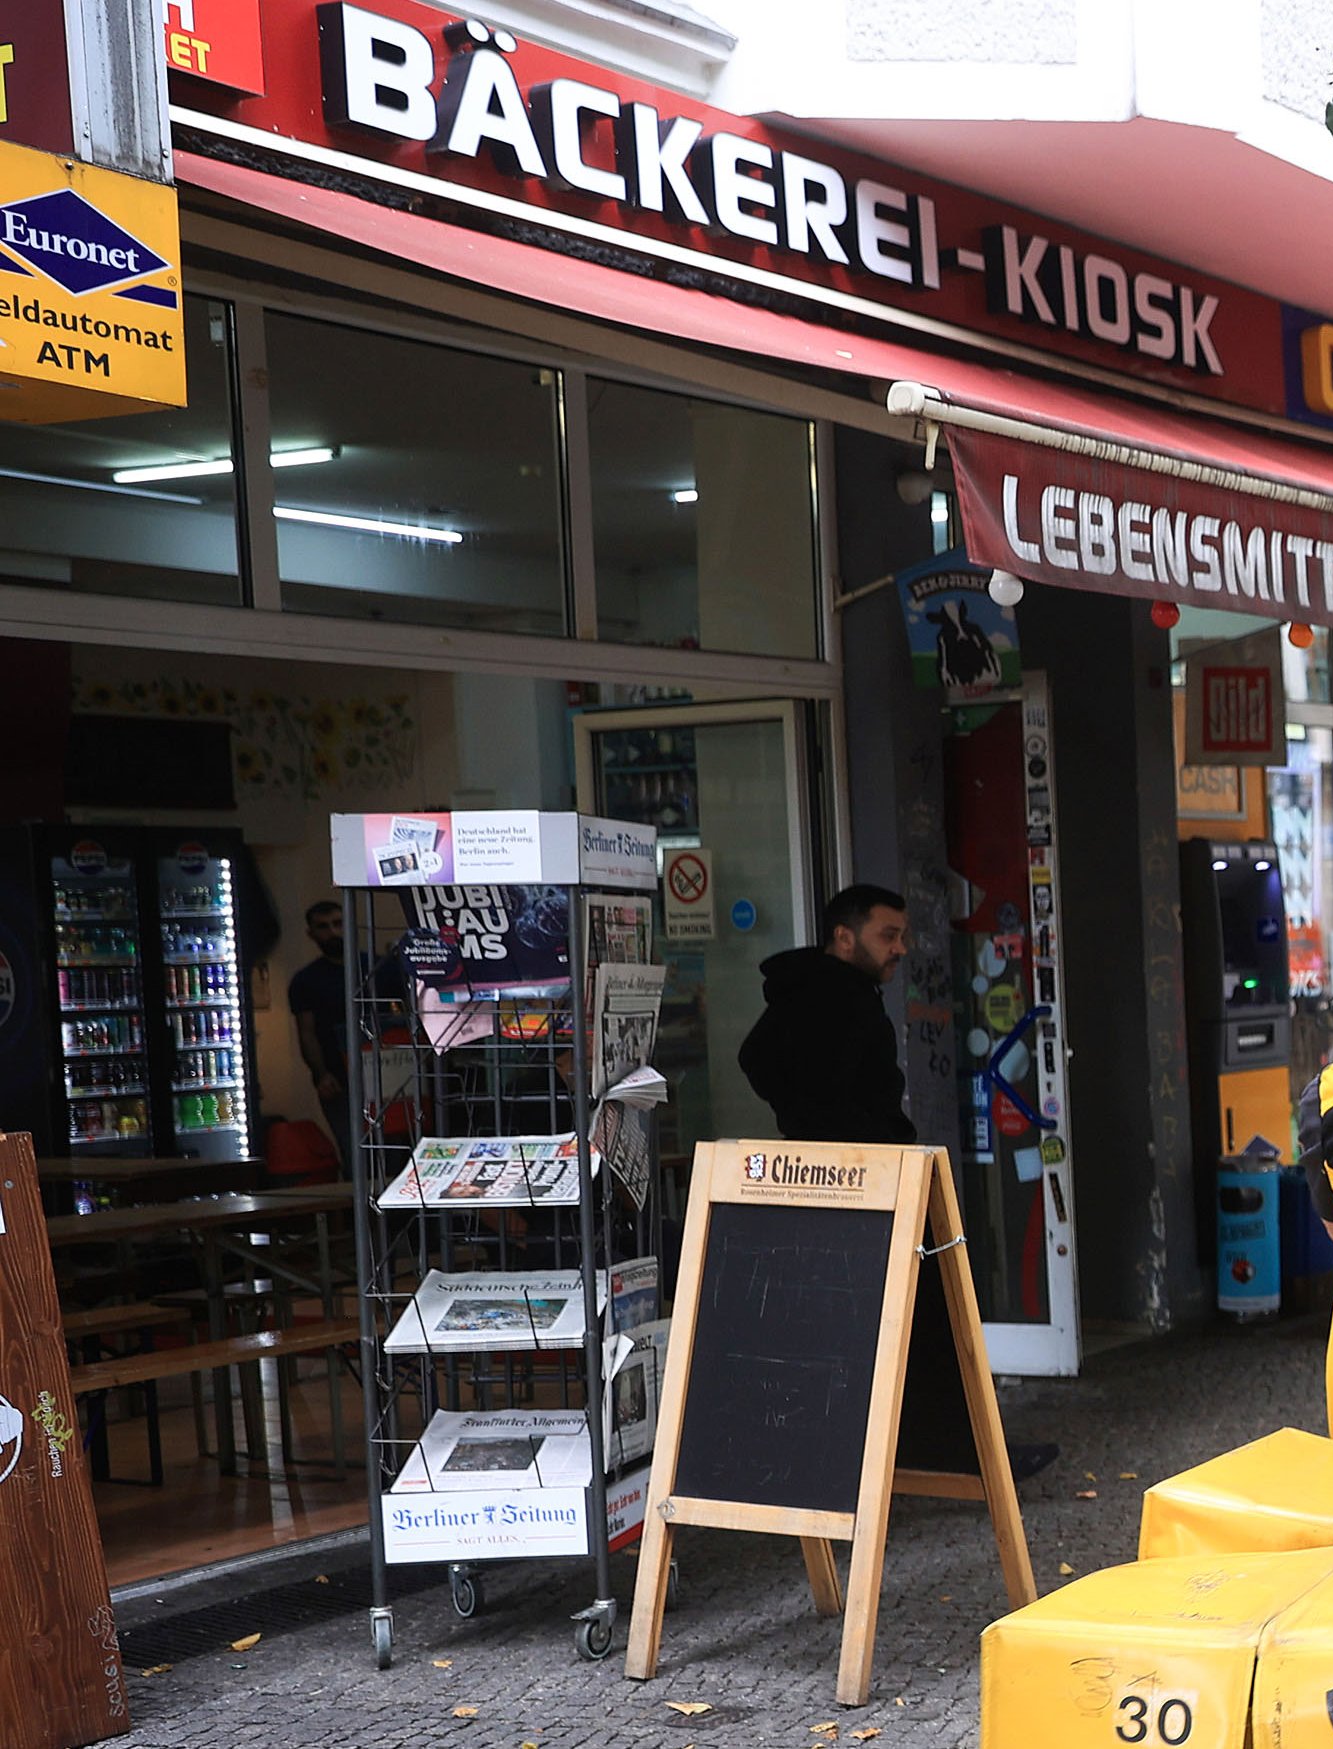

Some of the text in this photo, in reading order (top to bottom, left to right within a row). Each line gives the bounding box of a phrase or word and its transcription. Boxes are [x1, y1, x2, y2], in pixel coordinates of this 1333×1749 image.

[338, 4, 1225, 377] BÄCKEREI-KIOSK
[1, 208, 141, 274] Euronet
[0, 294, 173, 352] eldautomat
[37, 341, 111, 378] ATM
[1210, 676, 1267, 742] Bild
[771, 1154, 867, 1188] Chiemseer
[392, 1504, 578, 1531] Berliner Zeitung
[1116, 1695, 1192, 1745] 30
